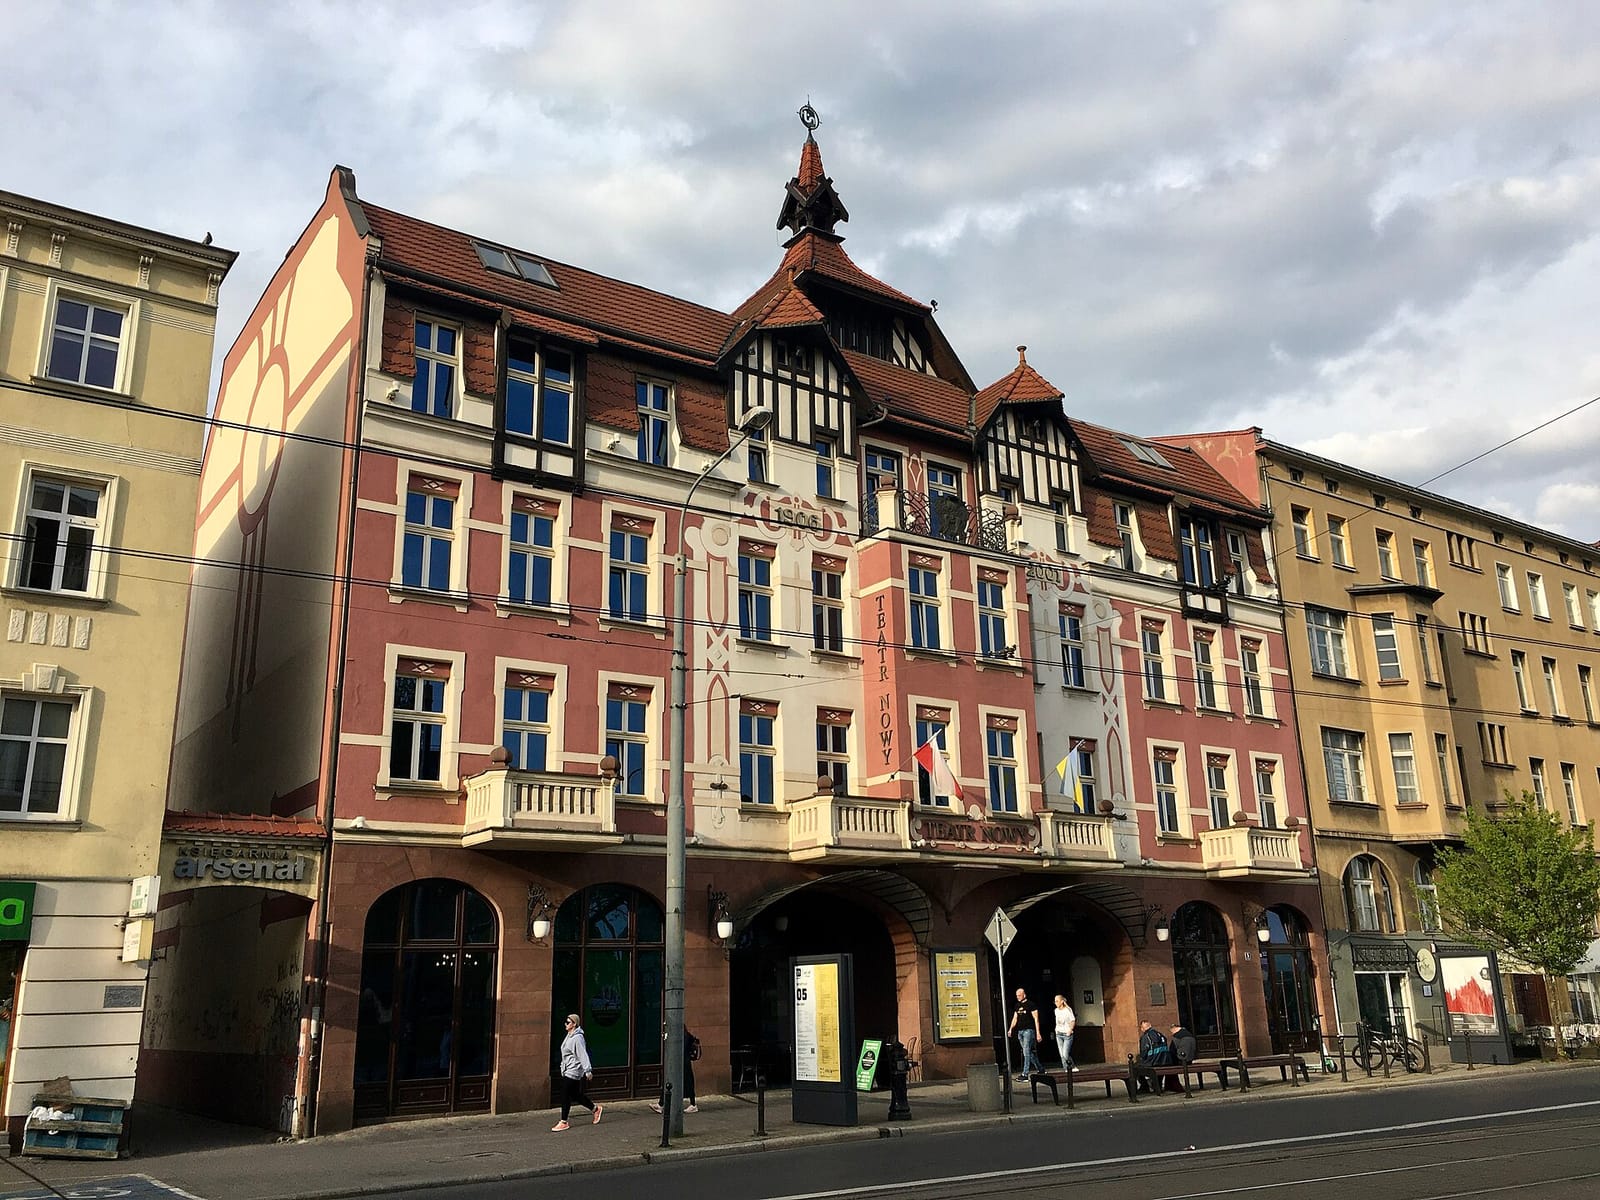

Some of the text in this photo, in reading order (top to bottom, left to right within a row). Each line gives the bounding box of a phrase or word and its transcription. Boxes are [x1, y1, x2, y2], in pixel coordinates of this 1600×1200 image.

[774, 506, 821, 532] 1906
[1025, 564, 1061, 584] 2001
[875, 594, 893, 766] TEATR NOWY
[926, 821, 1030, 846] TEATR NOWY
[796, 988, 807, 1001] 05
